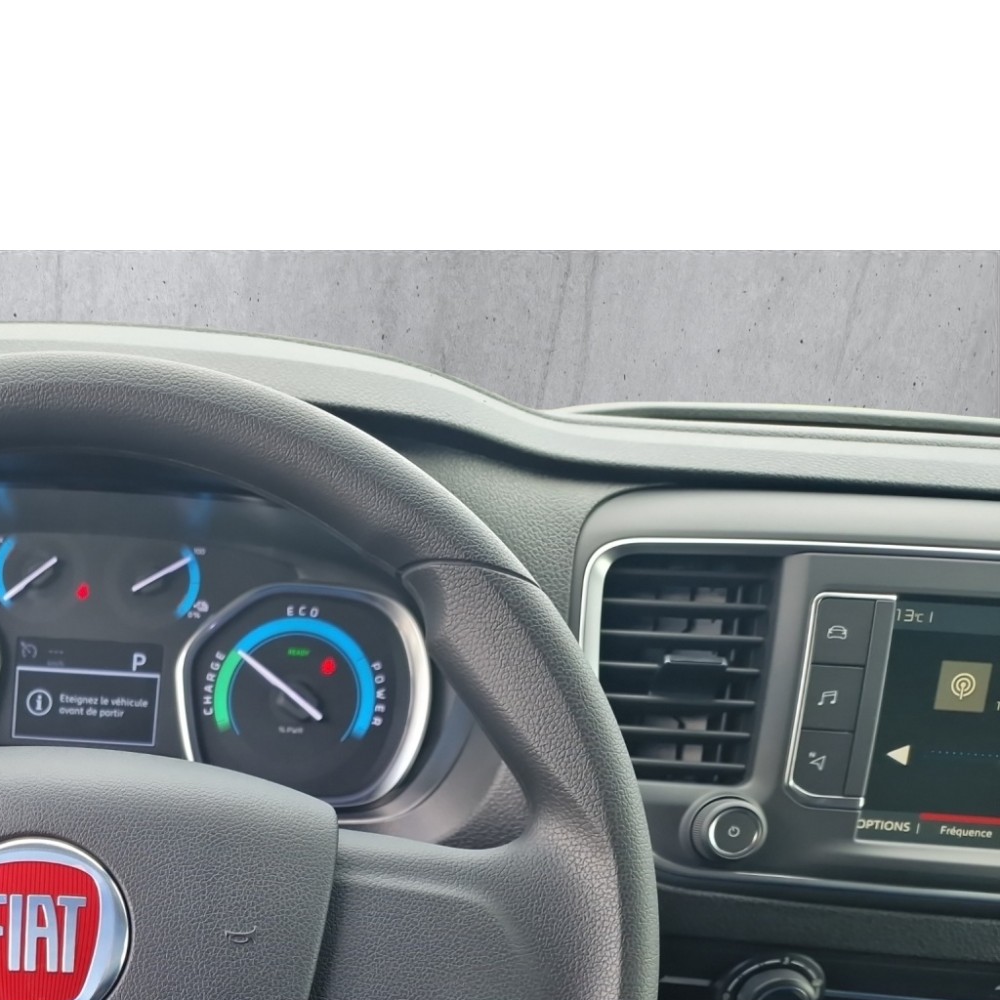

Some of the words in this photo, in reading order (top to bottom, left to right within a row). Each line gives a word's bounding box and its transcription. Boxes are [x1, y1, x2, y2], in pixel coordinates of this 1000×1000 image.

[286, 605, 320, 618] ECO
[132, 652, 147, 672] P
[203, 651, 226, 717] CHARGE
[60, 693, 99, 706] Eteignez
[100, 696, 109, 705] le
[111, 696, 149, 708] véhicule
[370, 662, 386, 727] POWER
[59, 707, 84, 716] avant
[86, 706, 98, 716] de
[99, 708, 125, 718] partir
[857, 819, 911, 833] OPTIONS
[940, 825, 993, 839] Fréquence
